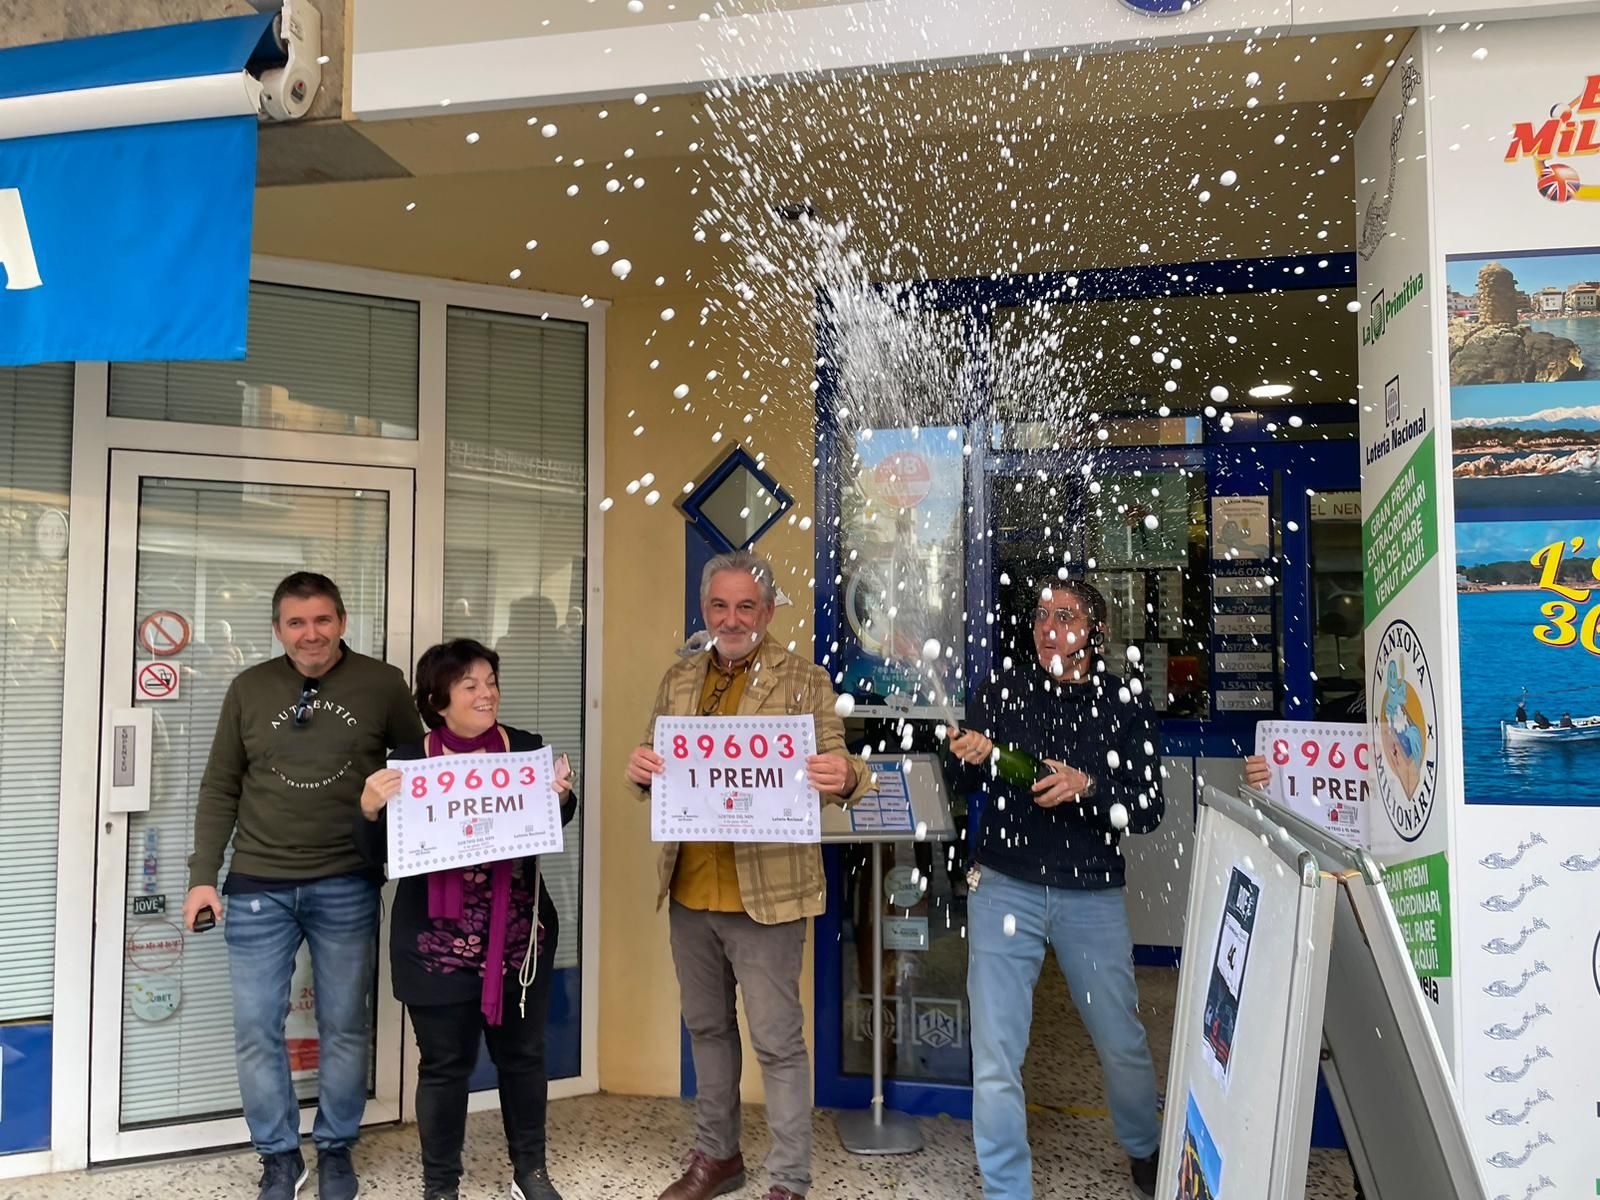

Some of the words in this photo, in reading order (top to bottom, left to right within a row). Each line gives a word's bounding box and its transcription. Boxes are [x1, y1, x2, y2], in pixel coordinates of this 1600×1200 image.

[1362, 326, 1371, 346] La
[1385, 272, 1424, 323] Primitiva
[1366, 433, 1391, 466] Lotería
[1391, 408, 1426, 450] Nacional
[1370, 501, 1391, 538] GRAN
[1391, 465, 1416, 511] PREMI
[1367, 480, 1426, 568] EXTRAORDINARI
[1373, 561, 1386, 584] DIA
[1386, 547, 1402, 570] DEL
[1402, 513, 1423, 552] PARE
[1375, 573, 1400, 606] VENUT
[1400, 539, 1425, 581] AQUÍ!
[1376, 628, 1425, 688] L'ANXOVA
[271, 699, 358, 730] AUTENTIC
[672, 733, 795, 759] 89603
[286, 779, 320, 789] CRAFTED
[411, 766, 536, 799] 89603
[710, 767, 784, 788] PREMI
[447, 794, 524, 819] PREMI
[1383, 870, 1402, 893] GRAN
[1403, 864, 1429, 889] PREMI
[134, 900, 159, 913] JOVE
[1414, 919, 1437, 942] PARE
[1414, 945, 1439, 970] AQUÍ!
